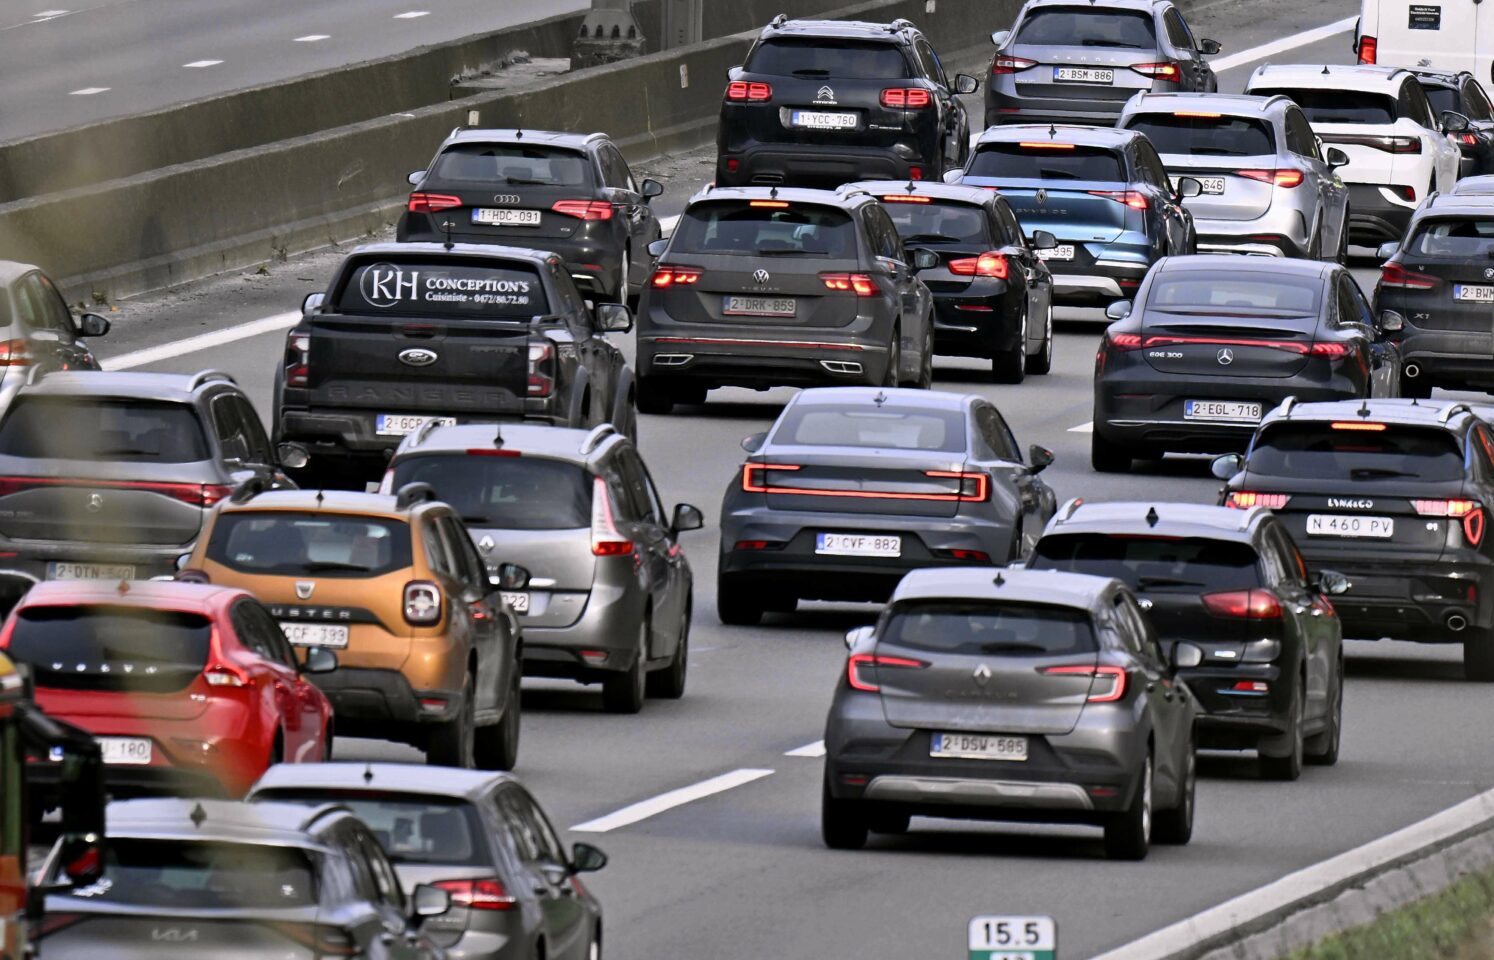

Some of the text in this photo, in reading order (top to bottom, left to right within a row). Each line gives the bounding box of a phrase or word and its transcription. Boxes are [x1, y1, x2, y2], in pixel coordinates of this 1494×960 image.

[480, 209, 539, 222] 1-HDC-091
[371, 269, 420, 301] KH
[425, 277, 530, 293] CONCEPTION'S
[424, 291, 468, 303] Cuisiniste
[1193, 402, 1259, 417] 2-EGL-718
[385, 416, 455, 429] 2-GCP-71
[825, 536, 899, 551] 2-CVF-882
[271, 607, 351, 619] USTER
[984, 922, 1040, 945] 15.5
